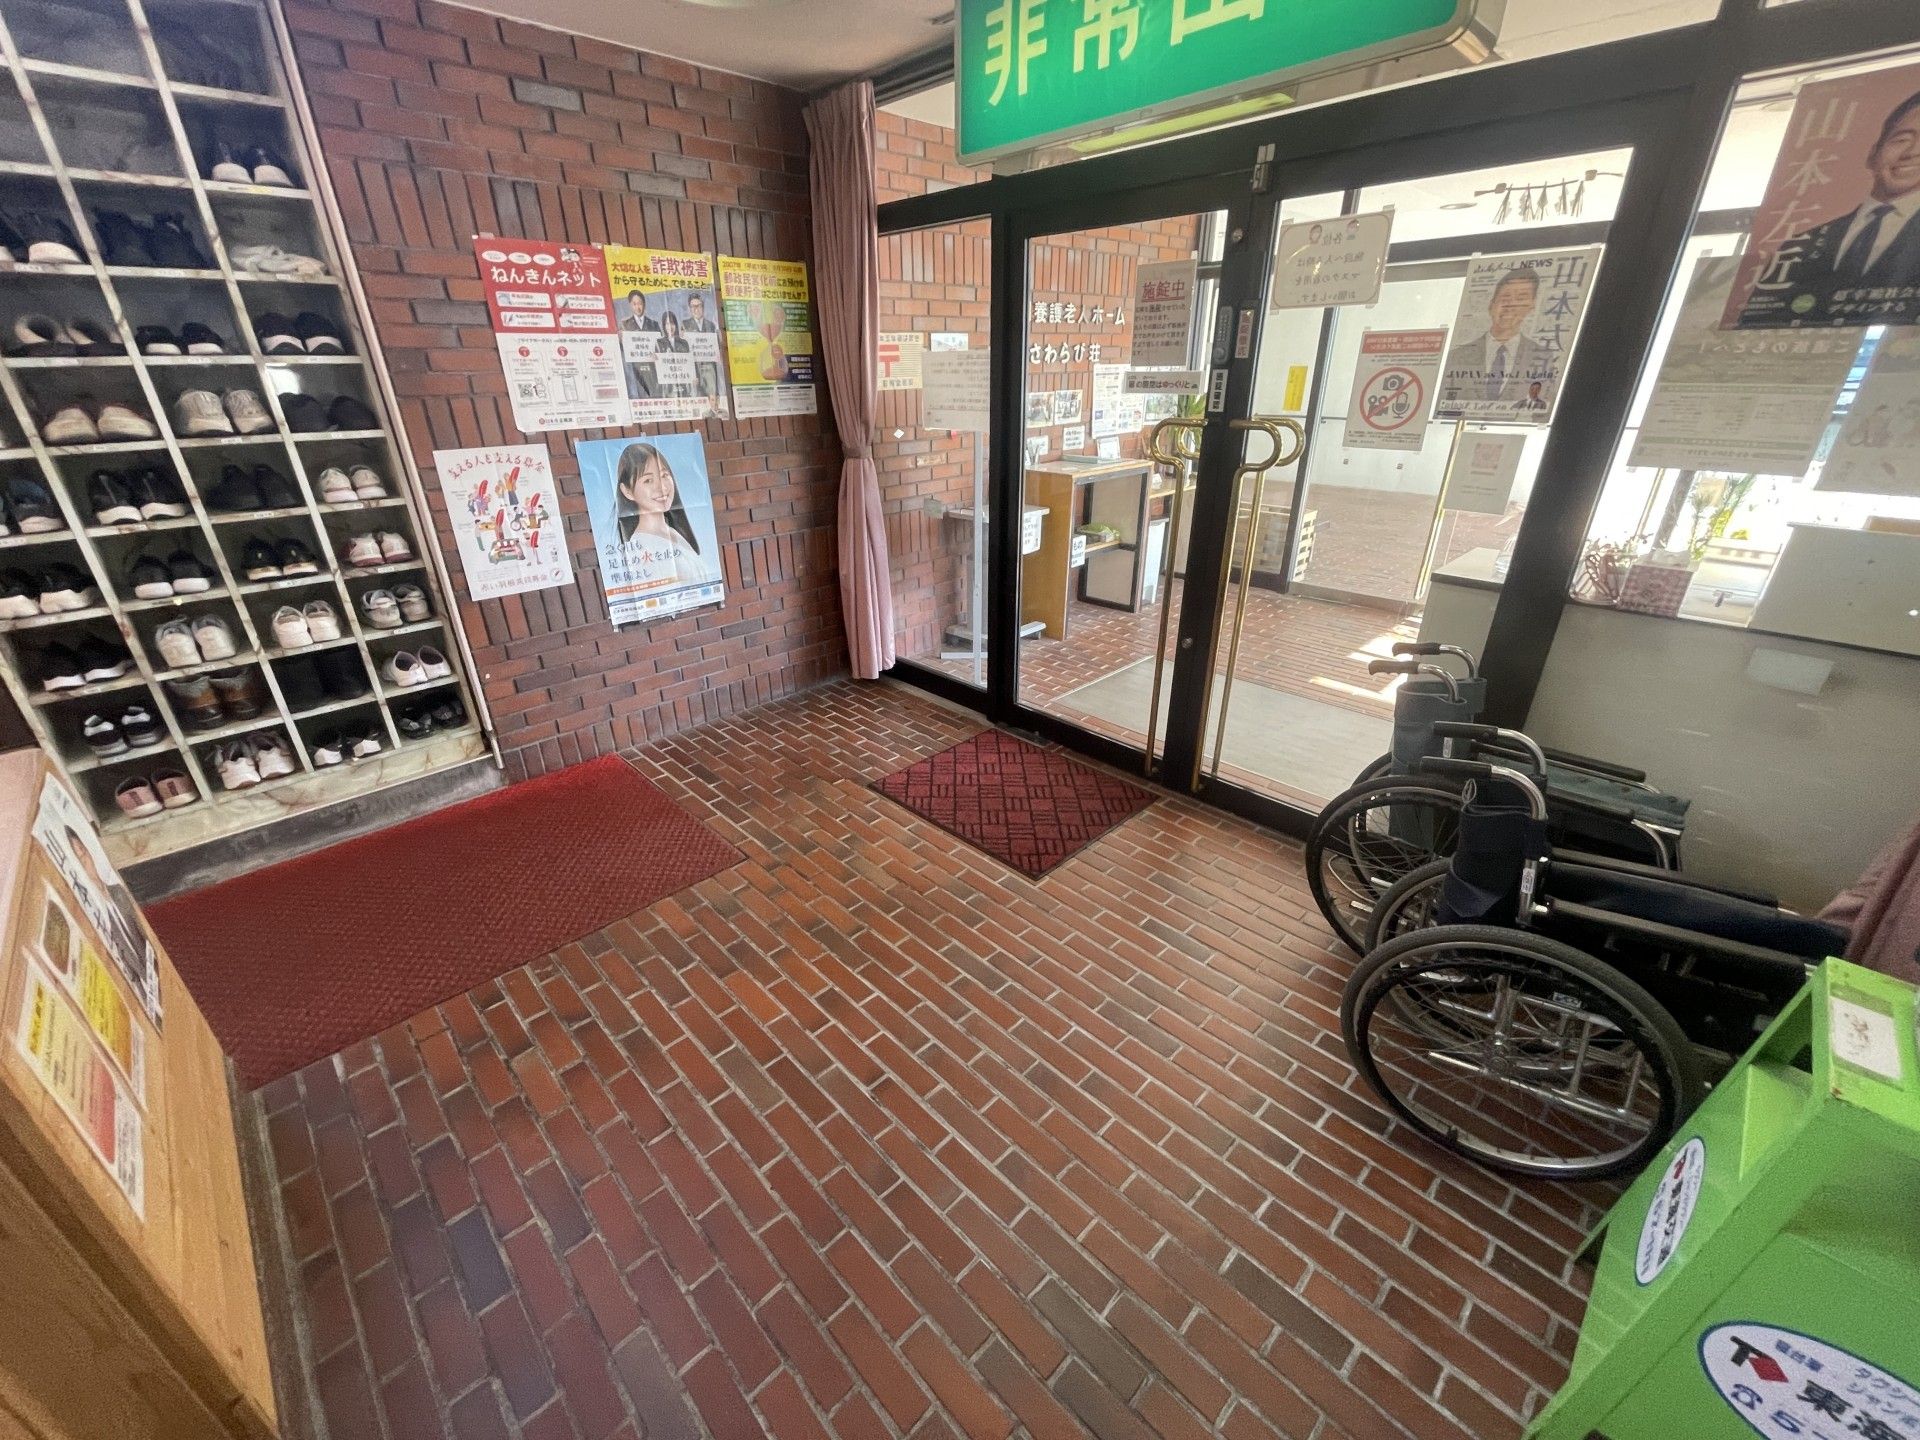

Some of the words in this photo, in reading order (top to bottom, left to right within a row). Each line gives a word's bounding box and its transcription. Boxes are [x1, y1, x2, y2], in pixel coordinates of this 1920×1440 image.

[1743, 97, 1858, 292] 山本左近
[1519, 257, 1553, 270] NEWS
[490, 266, 601, 288] ねんきんネット
[1142, 280, 1185, 299] 施錠中
[1034, 301, 1126, 325] 養護老人ホーム
[1029, 341, 1101, 364] さわらび荘
[608, 549, 682, 570] 足止め火を止め
[610, 568, 652, 583] 準備よし
